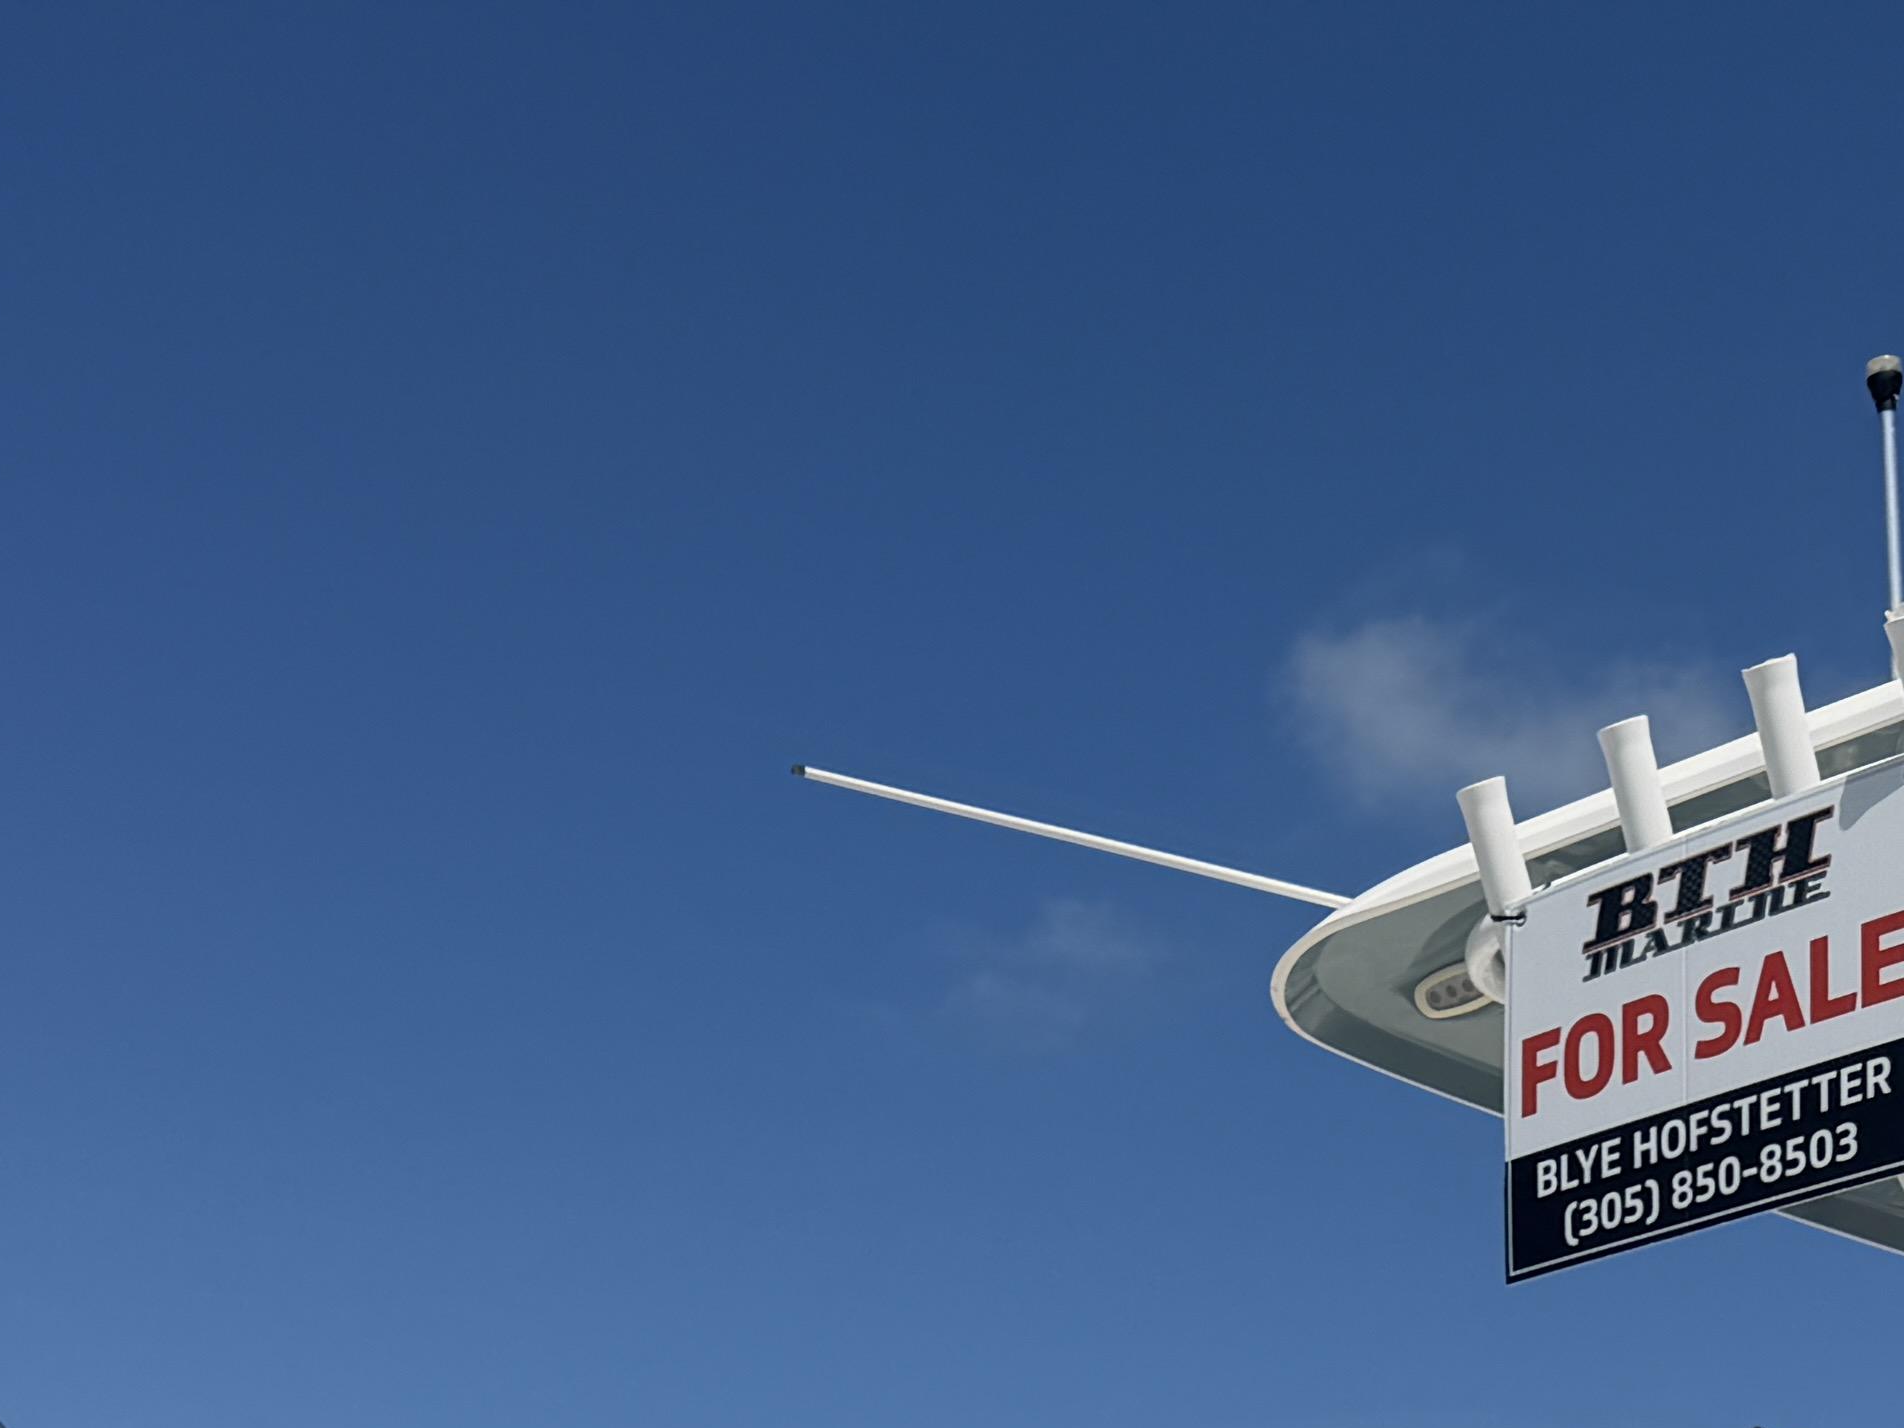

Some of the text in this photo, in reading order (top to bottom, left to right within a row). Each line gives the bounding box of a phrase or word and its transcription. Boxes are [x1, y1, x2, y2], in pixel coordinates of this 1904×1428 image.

[1582, 804, 1835, 954] BTH
[1582, 869, 1831, 983] MARINE
[1521, 992, 1673, 1119] FOR
[1536, 1055, 1893, 1199] BLYE HOFSTETTER
[1563, 1123, 1859, 1247] (305) 850-8503
